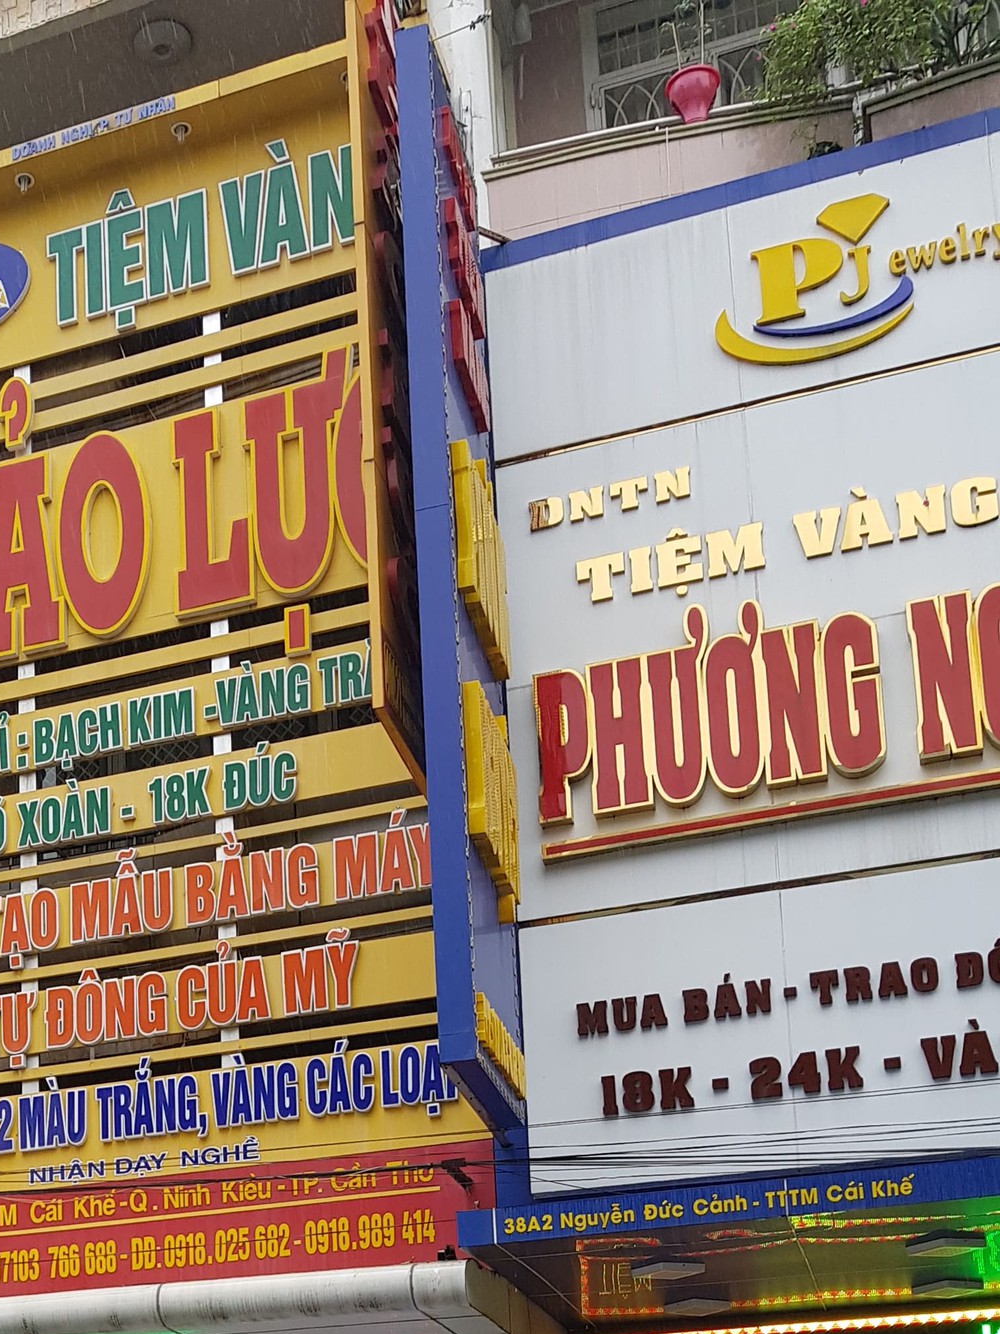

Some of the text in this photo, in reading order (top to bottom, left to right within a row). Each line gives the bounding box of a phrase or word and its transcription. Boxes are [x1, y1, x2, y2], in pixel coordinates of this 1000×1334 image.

[12, 136, 56, 161] DOANH
[138, 96, 176, 120] NHÂN
[45, 187, 211, 333] TIỆM
[173, 344, 369, 658] LỰ
[529, 464, 693, 534] DNTN
[575, 476, 1000, 604] TIỆM VÀNG
[32, 702, 124, 772] BẠCH
[126, 686, 195, 747] KIM
[532, 599, 888, 828] PHƯƠNG
[18, 778, 112, 851] XOÀN
[146, 765, 214, 826] 18K
[222, 740, 300, 811] ĐÚC
[69, 846, 174, 944] MẪU
[184, 830, 321, 927] BẰNG
[175, 940, 272, 1031] CỦA
[280, 927, 360, 1016] MỸ
[576, 956, 941, 1040] MUA BÁN TRAO
[19, 1075, 88, 1151] MÀU
[212, 1052, 299, 1130] VÀNG
[305, 1038, 375, 1117] CÁC
[601, 1045, 865, 1118] 18K 24K
[28, 1136, 261, 1184] NHẬN DẠY NGHỀ
[30, 1199, 63, 1224] Cái
[74, 1188, 116, 1219] Khế
[163, 1184, 210, 1210] Ninh
[48, 1244, 81, 1279] 766
[85, 1240, 117, 1275] 688
[254, 1223, 290, 1260] 682
[402, 1208, 436, 1245] 414
[503, 1172, 916, 1236] 38A2 Nguyễn Đức Cảnh TTTM Cái Khế
